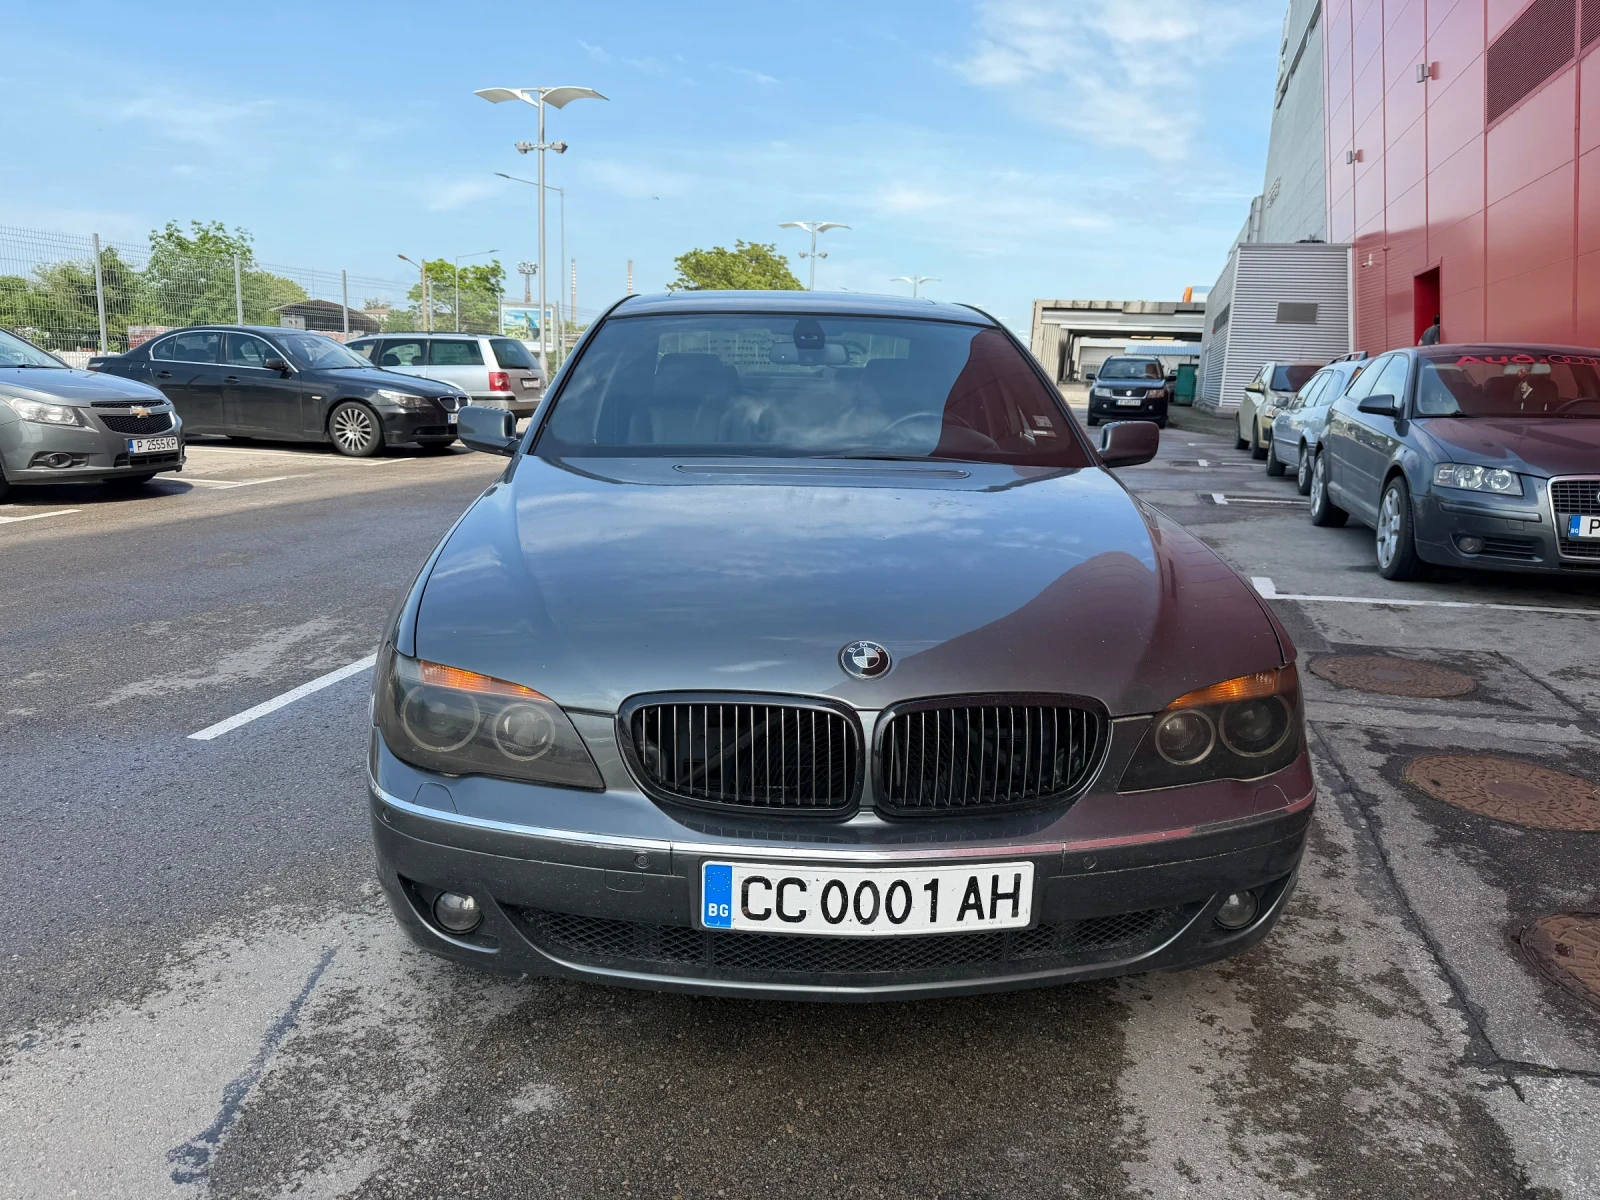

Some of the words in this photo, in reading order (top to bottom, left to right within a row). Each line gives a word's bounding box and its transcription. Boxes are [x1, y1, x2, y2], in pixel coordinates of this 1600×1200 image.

[137, 440, 143, 451] P
[146, 439, 166, 451] 2555
[166, 438, 176, 449] KP
[847, 643, 883, 653] BMW
[740, 875, 807, 923] CC
[820, 877, 940, 926] 0001
[956, 873, 1022, 922] AH
[708, 903, 729, 917] BG
